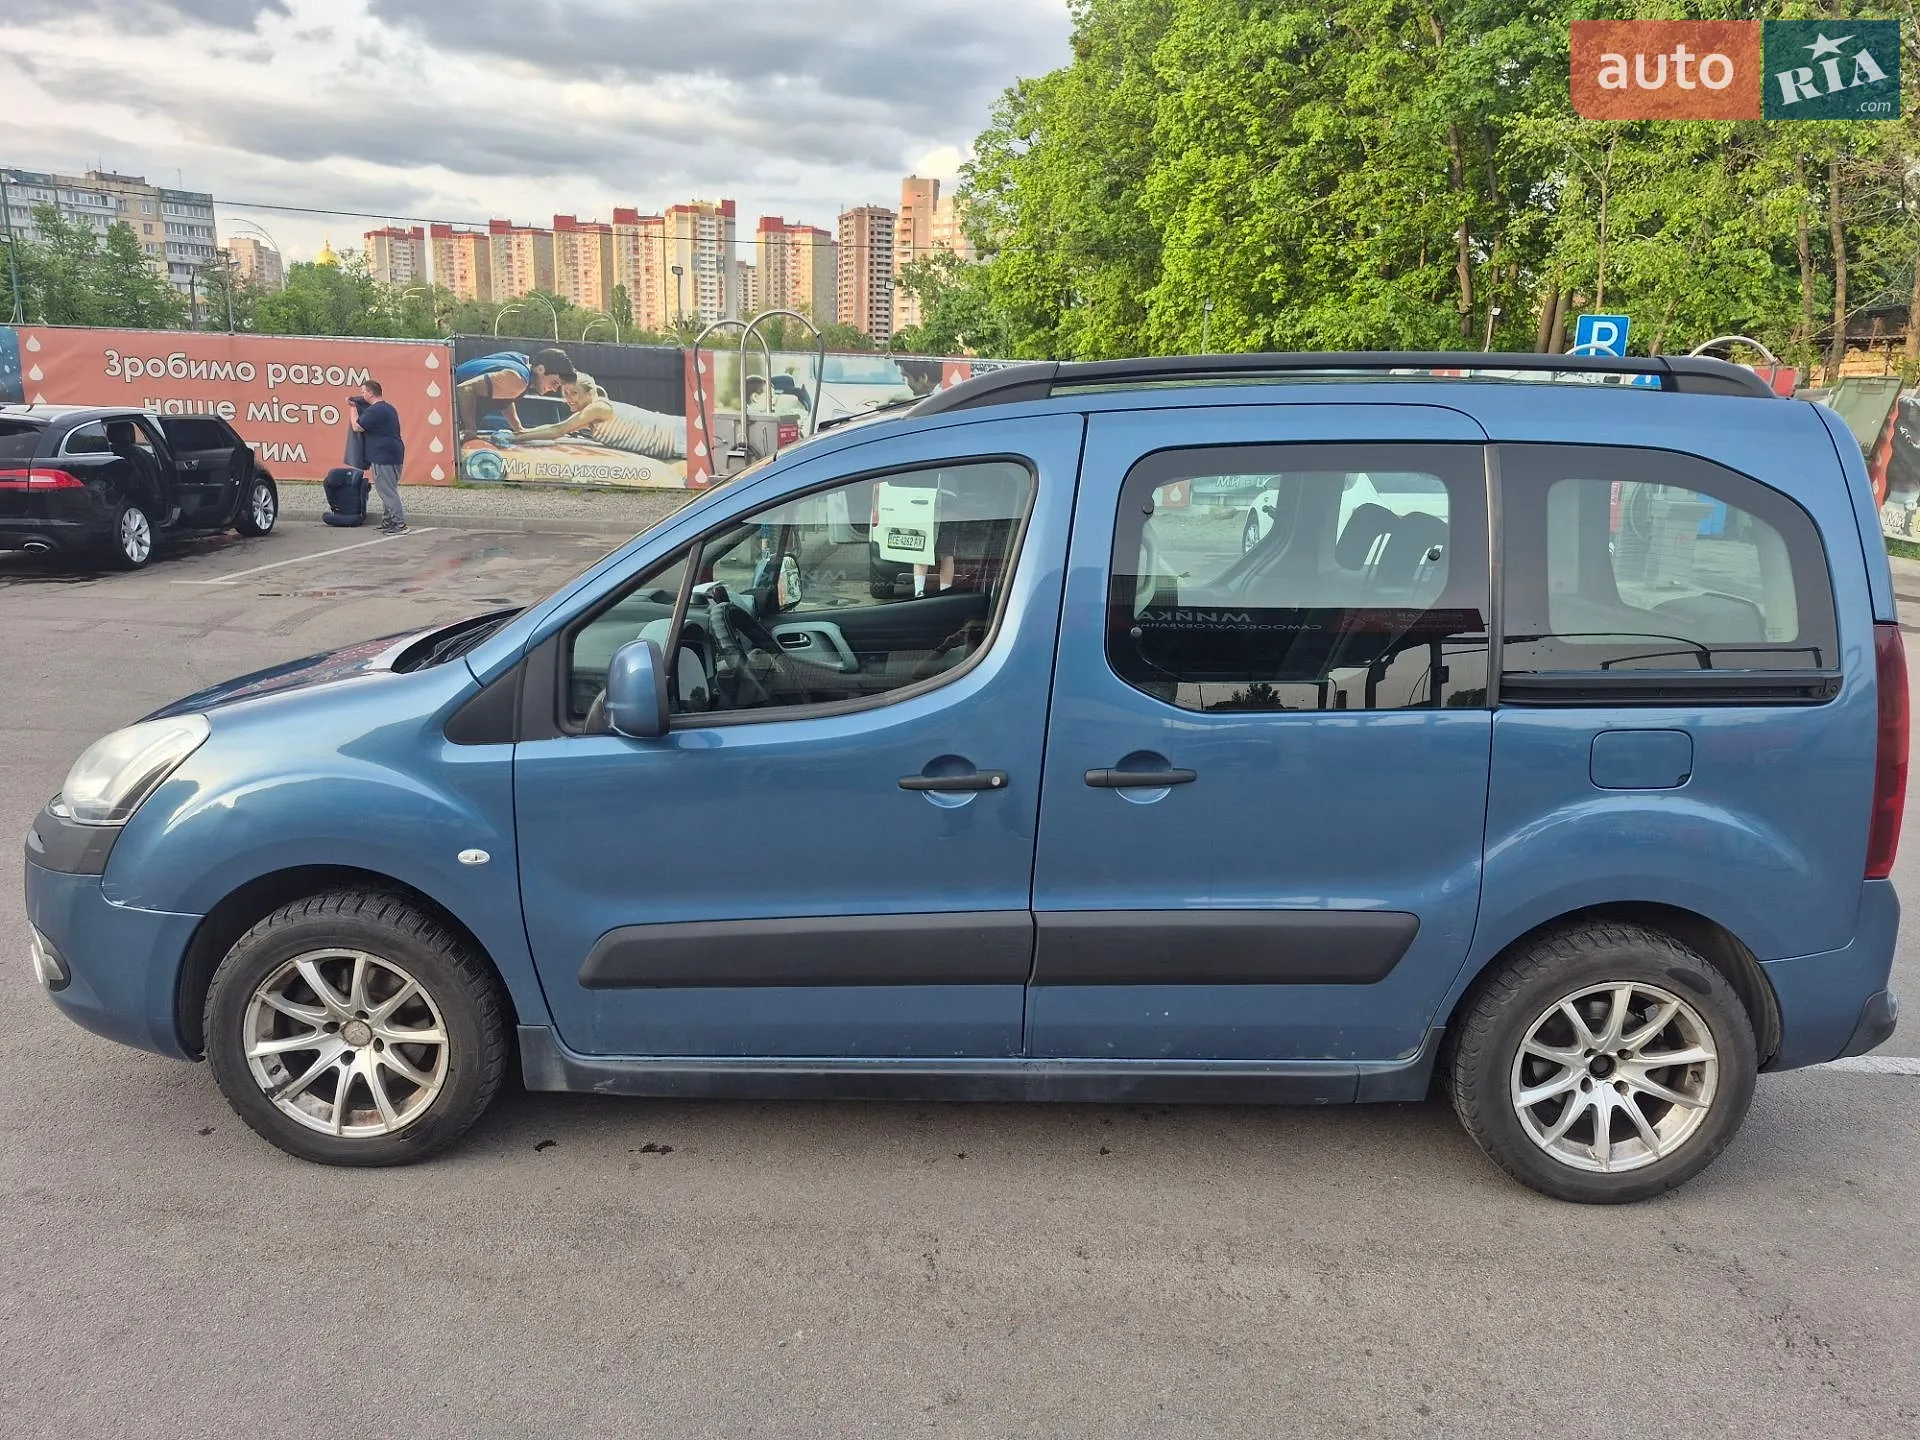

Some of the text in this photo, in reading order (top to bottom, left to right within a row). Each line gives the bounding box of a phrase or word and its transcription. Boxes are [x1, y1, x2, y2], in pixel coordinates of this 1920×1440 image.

[104, 349, 371, 388] Зробимо разом
[144, 396, 341, 425] наше місто
[246, 440, 308, 463] тим
[501, 458, 651, 481] Ми надихаємо
